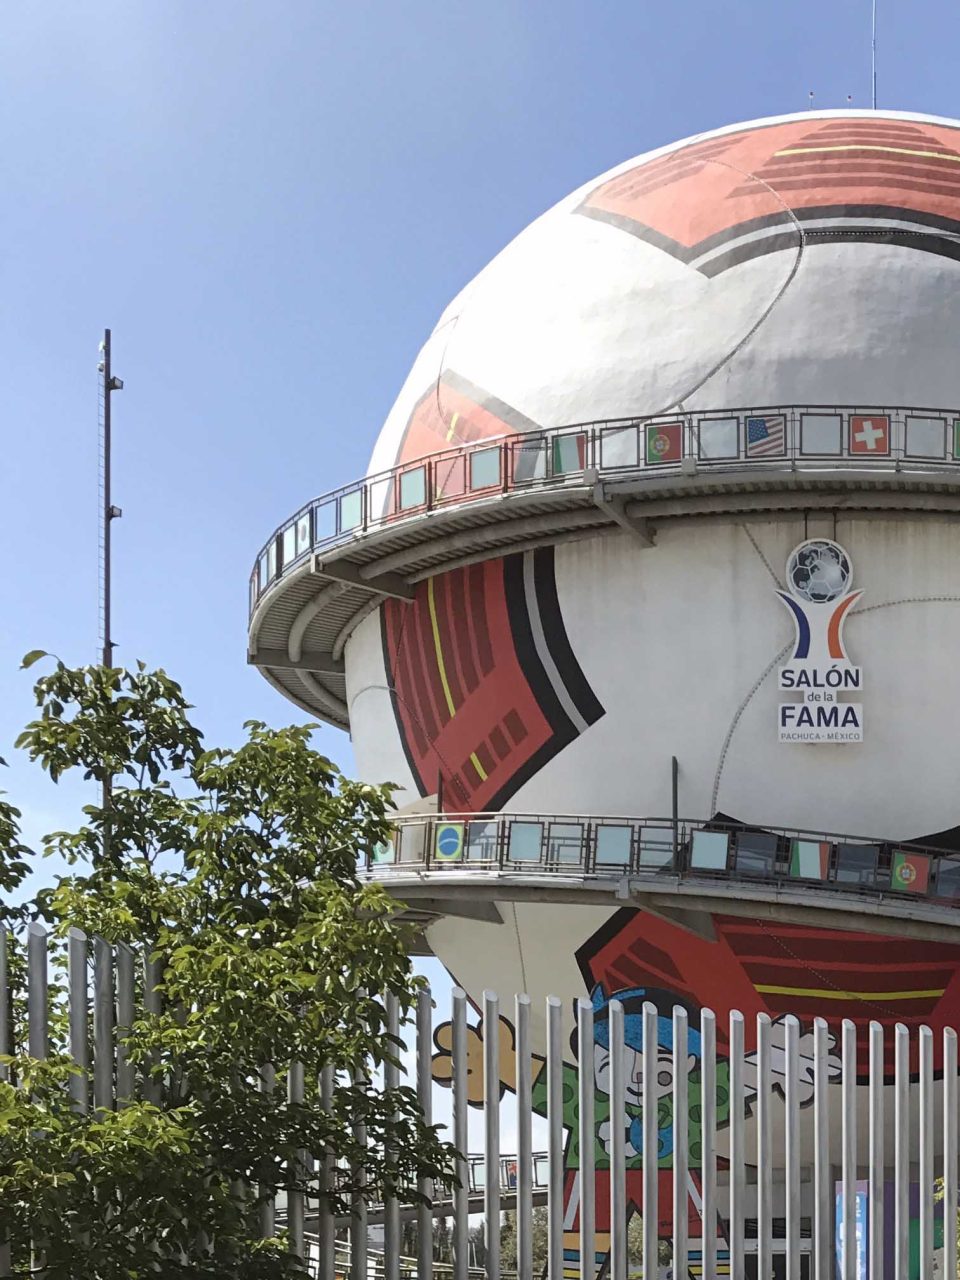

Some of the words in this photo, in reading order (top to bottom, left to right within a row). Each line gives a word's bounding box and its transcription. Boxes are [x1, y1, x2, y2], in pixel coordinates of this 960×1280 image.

[780, 664, 860, 688] SALÓN
[807, 691, 822, 702] de
[823, 691, 834, 702] la
[780, 705, 860, 728] FAMA
[780, 732, 821, 741] PACHUCA
[826, 730, 860, 741] MÉXICO
